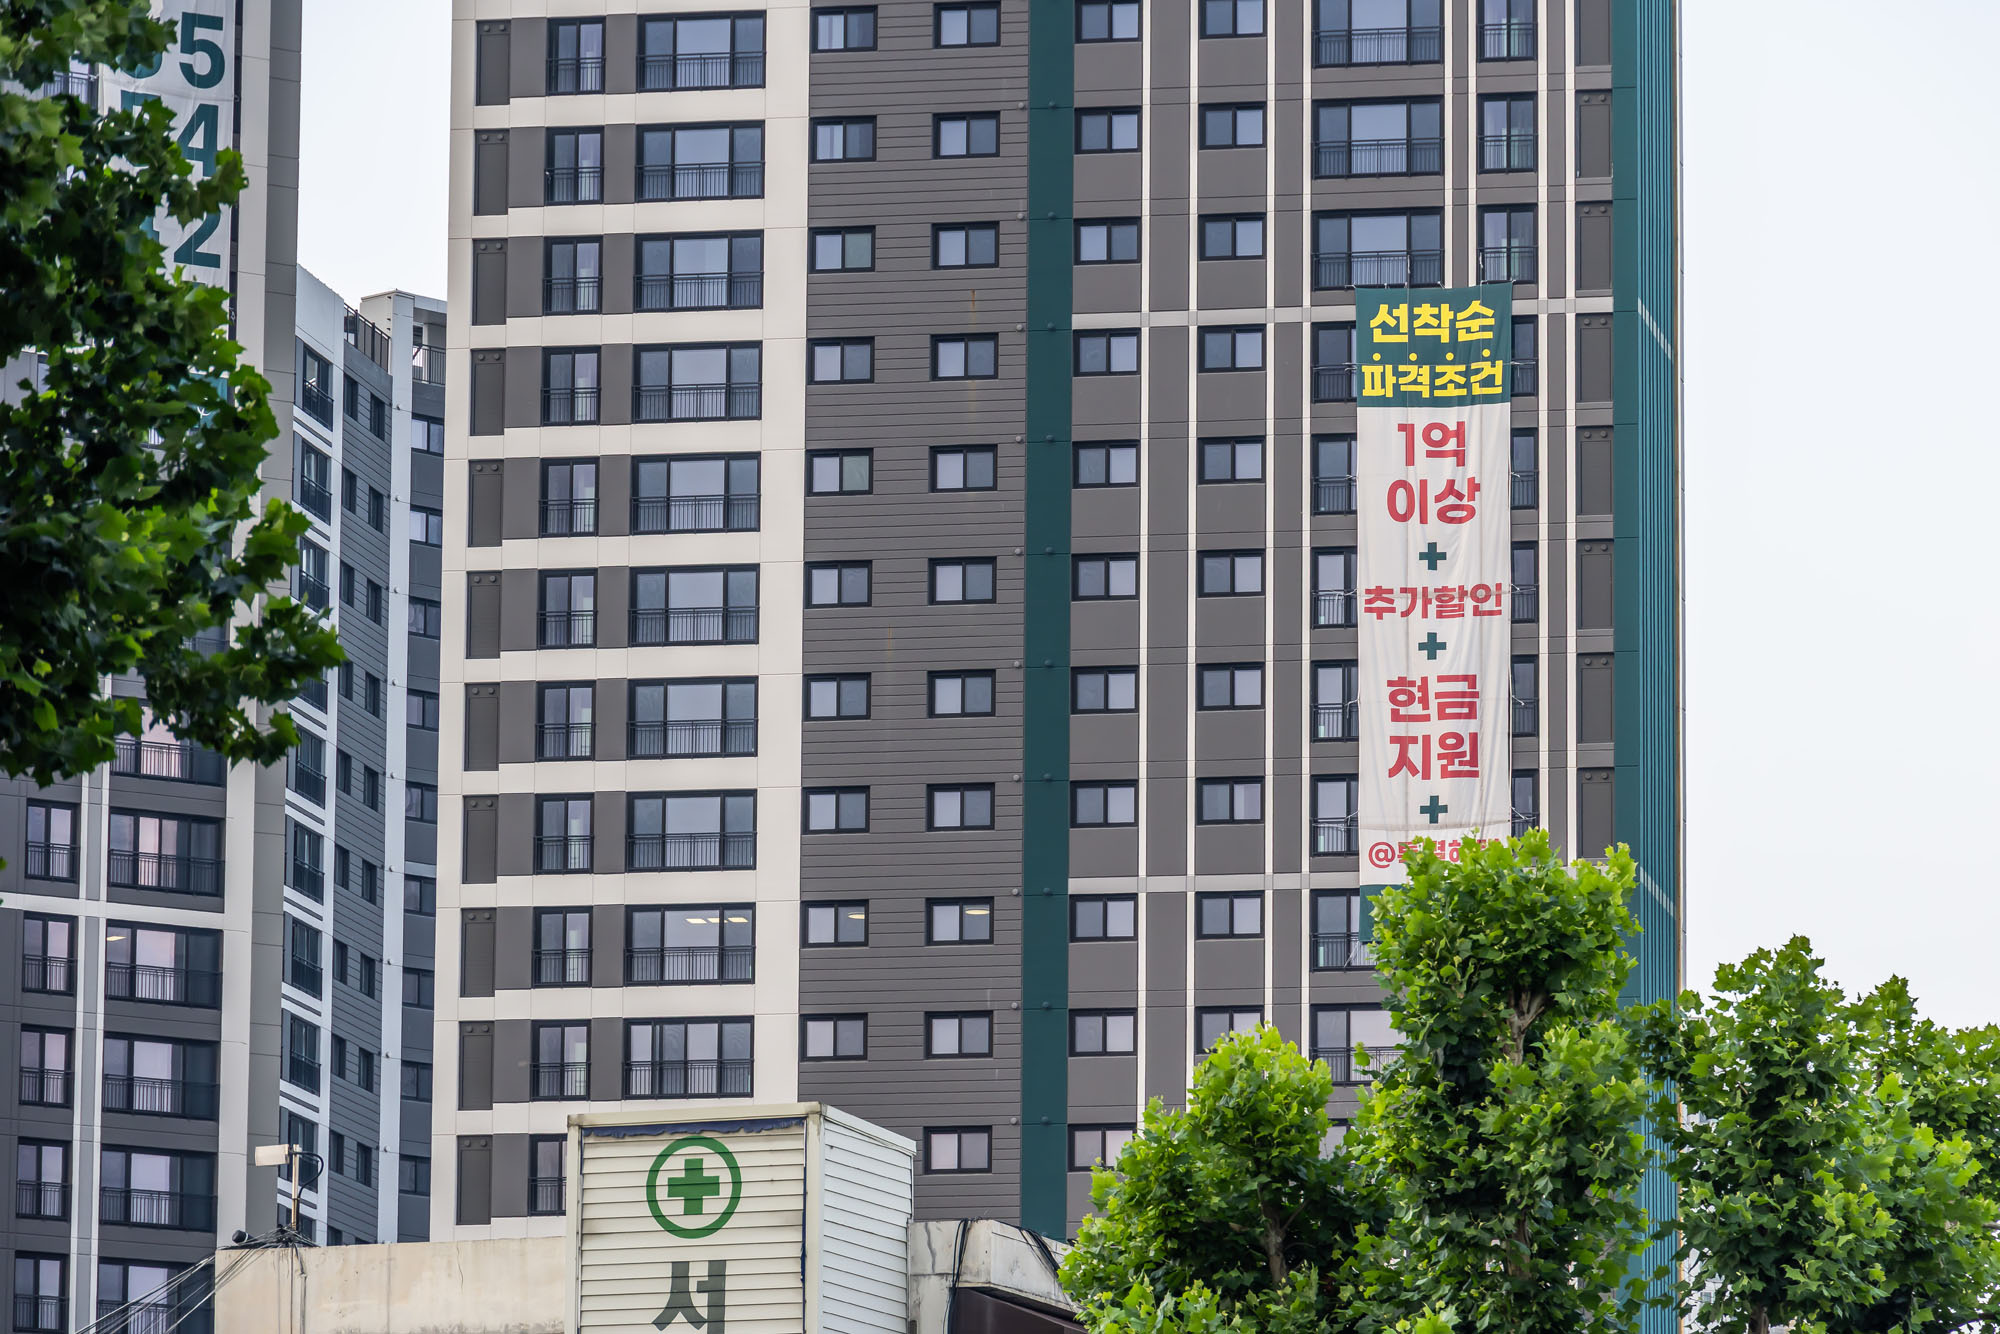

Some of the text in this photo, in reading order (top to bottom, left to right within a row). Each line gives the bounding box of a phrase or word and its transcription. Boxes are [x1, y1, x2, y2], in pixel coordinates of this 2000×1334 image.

[1369, 300, 1495, 343] 선착순
[1361, 360, 1503, 398] 파격조건
[1397, 421, 1466, 467] 1억
[1387, 476, 1480, 524] 이상
[1363, 582, 1502, 620] 추가할인
[1387, 674, 1479, 723] 현금
[1388, 731, 1479, 780] 지원
